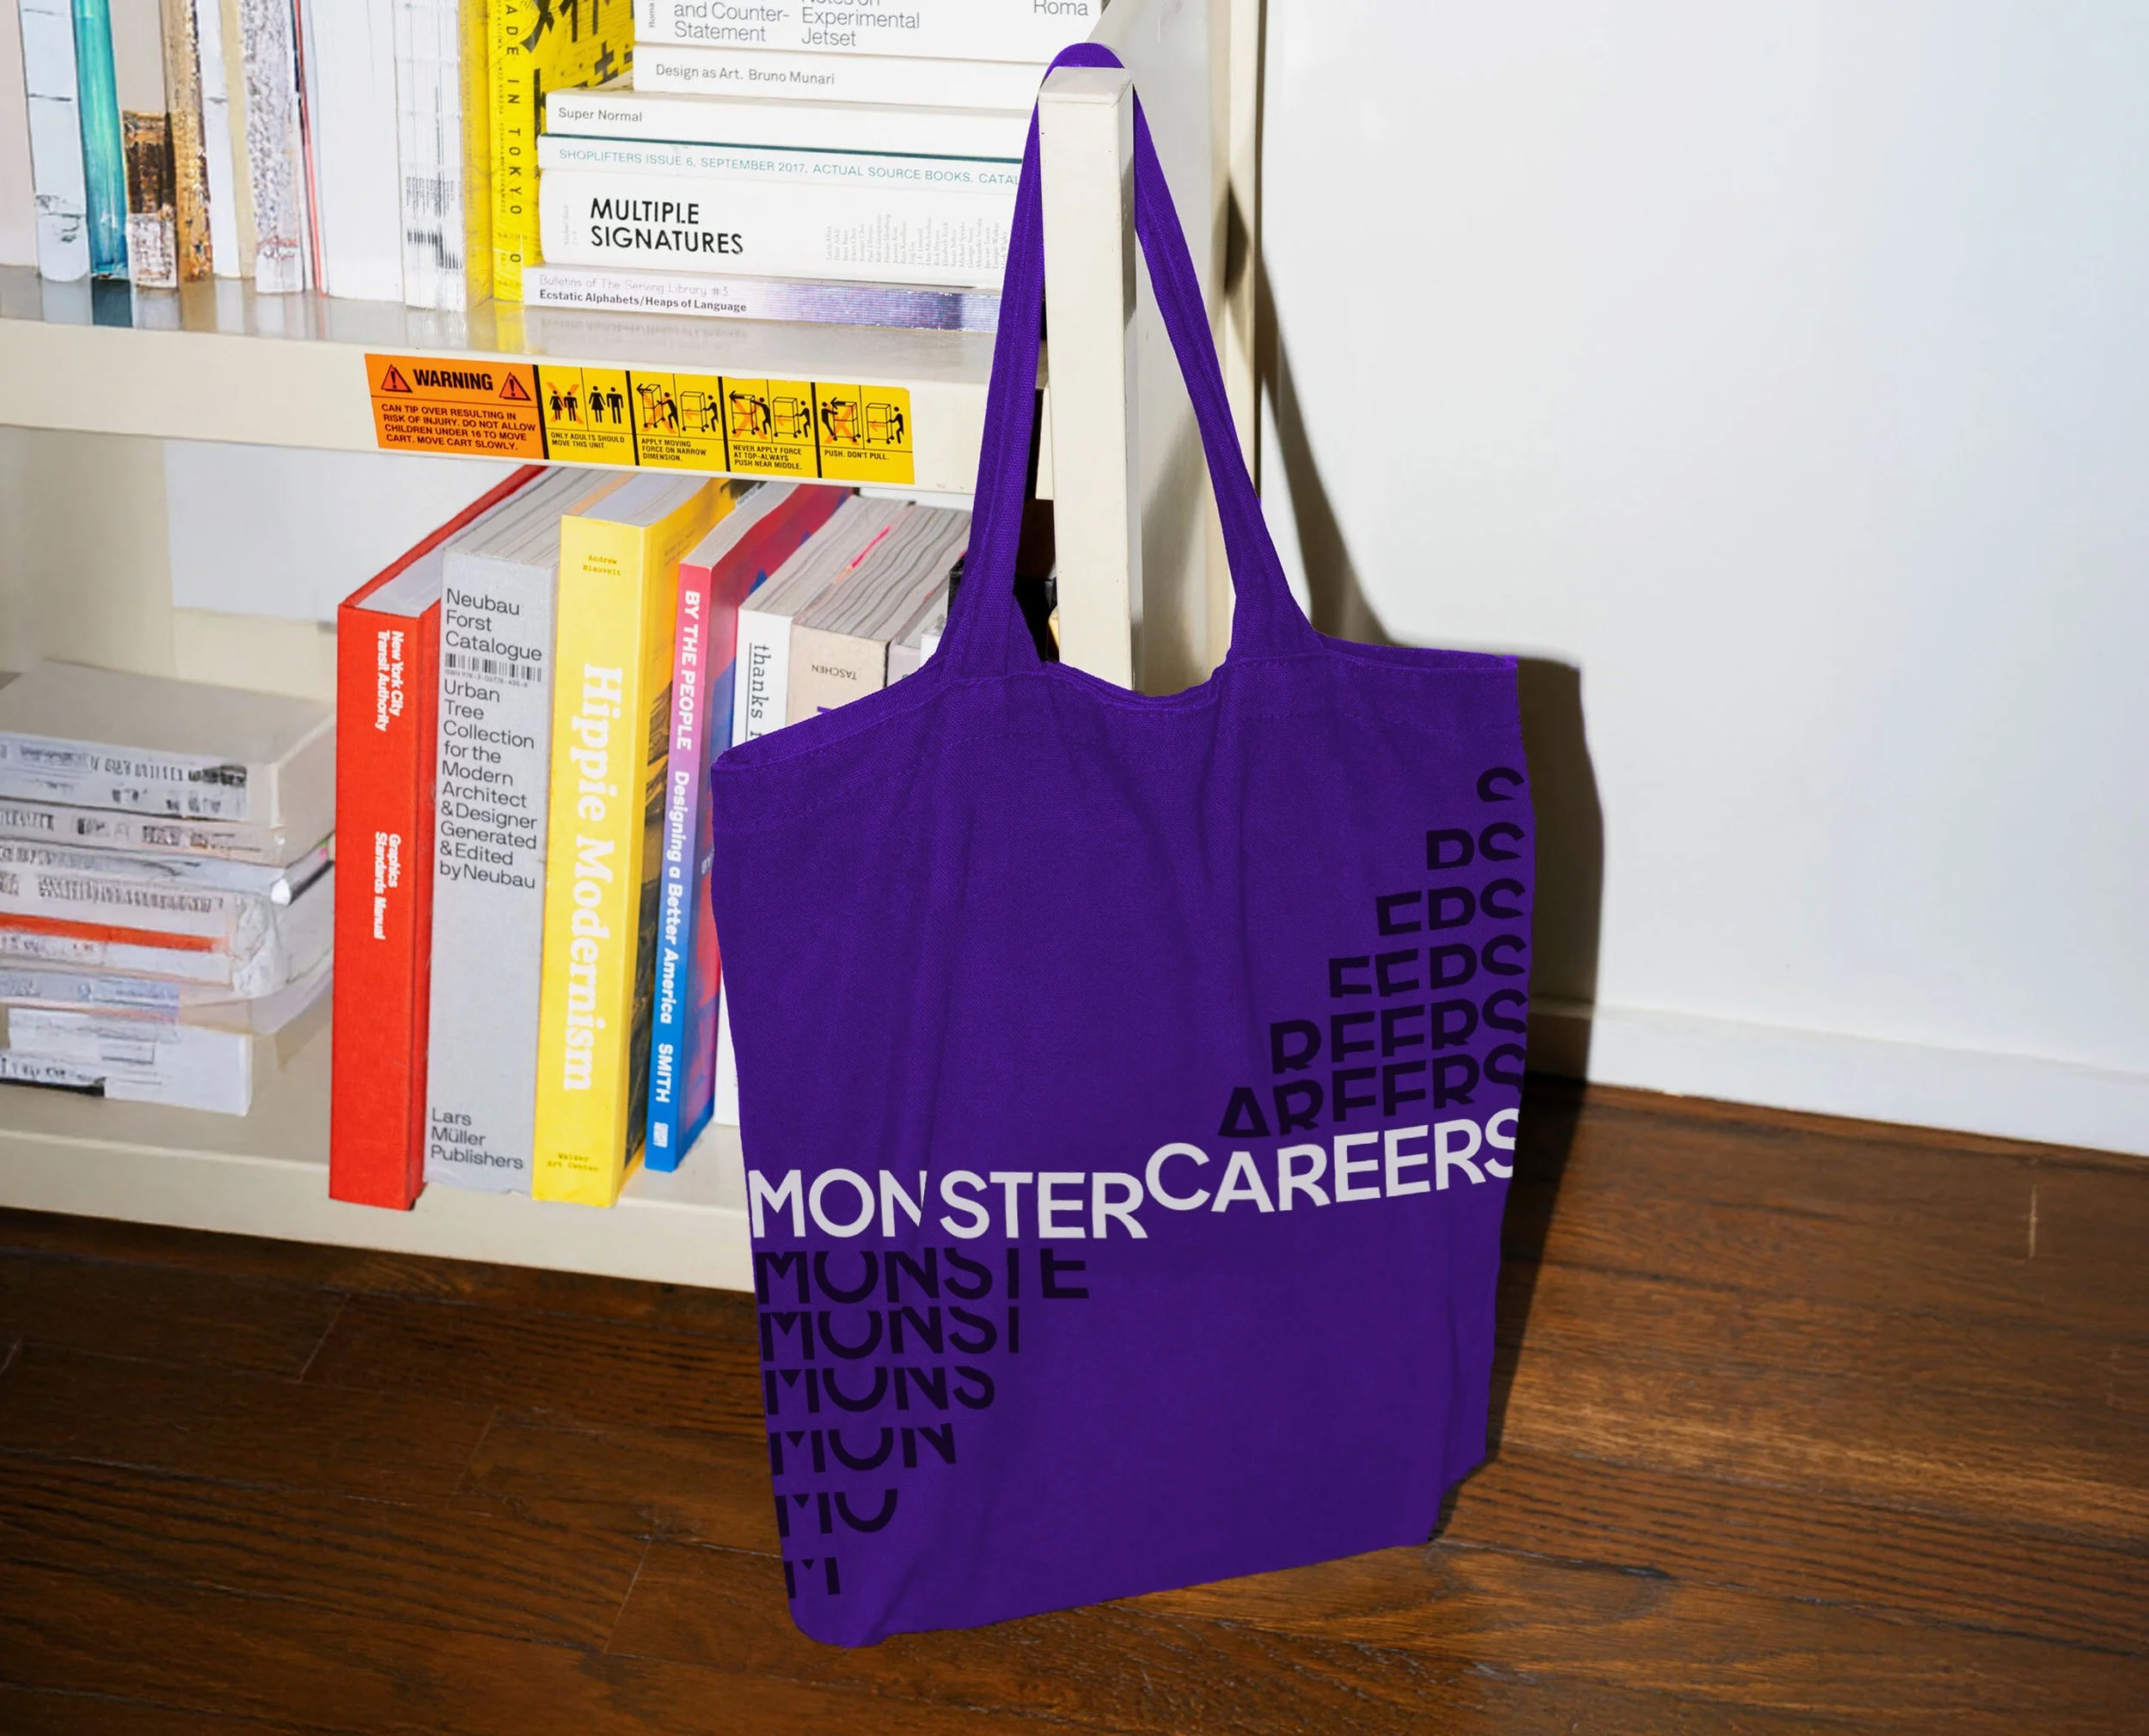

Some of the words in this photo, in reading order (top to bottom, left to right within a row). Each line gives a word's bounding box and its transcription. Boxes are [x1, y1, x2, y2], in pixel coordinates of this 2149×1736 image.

[675, 2, 707, 18] and
[712, 3, 789, 21] Counter-
[802, 7, 920, 29] Experimental
[1034, 0, 1088, 15] Roma
[505, 0, 519, 55] ADE
[675, 21, 766, 42] Statement
[801, 28, 856, 46] Jetset
[656, 64, 699, 80] Design
[702, 68, 716, 78] as
[719, 68, 744, 80] Art.
[749, 69, 787, 82] Bruno
[789, 71, 835, 85] Munari
[507, 79, 520, 104] IN
[559, 107, 595, 119] Super
[598, 110, 642, 122] Normal
[509, 128, 523, 214] TOKYO
[560, 149, 642, 163] SHOPLIFTERS
[646, 155, 682, 166] ISSUE
[701, 157, 774, 171] SEPTEMBER
[813, 164, 864, 176] ACTUAL
[868, 167, 921, 180] SOURCE
[590, 198, 699, 225] MULTIPLE
[591, 225, 744, 255] SIGNATURES
[539, 274, 582, 288] Bulletins
[586, 278, 597, 288] of
[602, 278, 621, 290] The
[625, 279, 664, 294] Serving
[668, 280, 707, 297] Library
[712, 286, 729, 297] #3
[539, 290, 584, 302] Ecstatic
[681, 298, 693, 309] of
[694, 299, 747, 312] Language
[413, 369, 493, 391] WARNING
[382, 403, 402, 413] CAN
[405, 405, 419, 413] TIP
[421, 406, 448, 416] OVER
[450, 408, 504, 419] RESULTING
[383, 413, 406, 423] RISK
[423, 417, 460, 426] INJURY.
[462, 419, 477, 428] DO
[479, 420, 499, 429] NOT
[501, 422, 536, 431] ALLOW
[384, 424, 432, 434] CHILDREN
[435, 427, 468, 437] UNDER
[499, 431, 527, 441] MOVE
[386, 434, 414, 443] CART.
[417, 436, 444, 445] MOVE
[446, 437, 472, 447] CART
[474, 439, 518, 450] SLOWLY.
[597, 434, 624, 443] SHOULD
[641, 437, 662, 446] APPLY
[643, 453, 682, 462] DIMENSION.
[733, 444, 755, 453] NEVER
[756, 445, 778, 454] APPLY
[780, 447, 802, 455] FORCE
[848, 450, 868, 459] DON'T
[774, 461, 802, 470] MIDDLE.
[588, 554, 617, 565] Andrew
[446, 588, 520, 616] Neubau
[684, 590, 701, 620] BY
[446, 608, 492, 632] Forst
[377, 629, 390, 672] Transit
[391, 630, 404, 661] New
[445, 630, 542, 661] Catalogue
[682, 624, 698, 666] THE
[391, 662, 404, 689] York
[751, 645, 771, 719] thanks
[811, 663, 857, 681] TASCHEN
[375, 672, 390, 731] Authority
[389, 689, 404, 717] City
[444, 679, 500, 702] Urban
[444, 699, 484, 720] Tree
[677, 669, 695, 750] PEOPLE
[444, 719, 534, 749] Collection
[571, 663, 622, 822] Hippie
[444, 740, 468, 758] for
[472, 745, 501, 763] the
[442, 760, 513, 786] Modern
[442, 780, 527, 809] Architect
[666, 771, 689, 862] Designing
[441, 821, 536, 850] Generated
[375, 831, 388, 894] Standards
[387, 833, 401, 888] Graphics
[669, 865, 682, 878] a
[439, 860, 461, 880] by
[464, 864, 536, 889] Neubau
[374, 896, 387, 939] Manual
[665, 883, 683, 945] Better
[564, 834, 615, 1091] Modernism
[660, 947, 679, 1024] America
[655, 1042, 674, 1103] SMITH
[432, 1107, 472, 1126] Lars
[432, 1127, 486, 1146] Müller
[431, 1145, 523, 1170] Publishers
